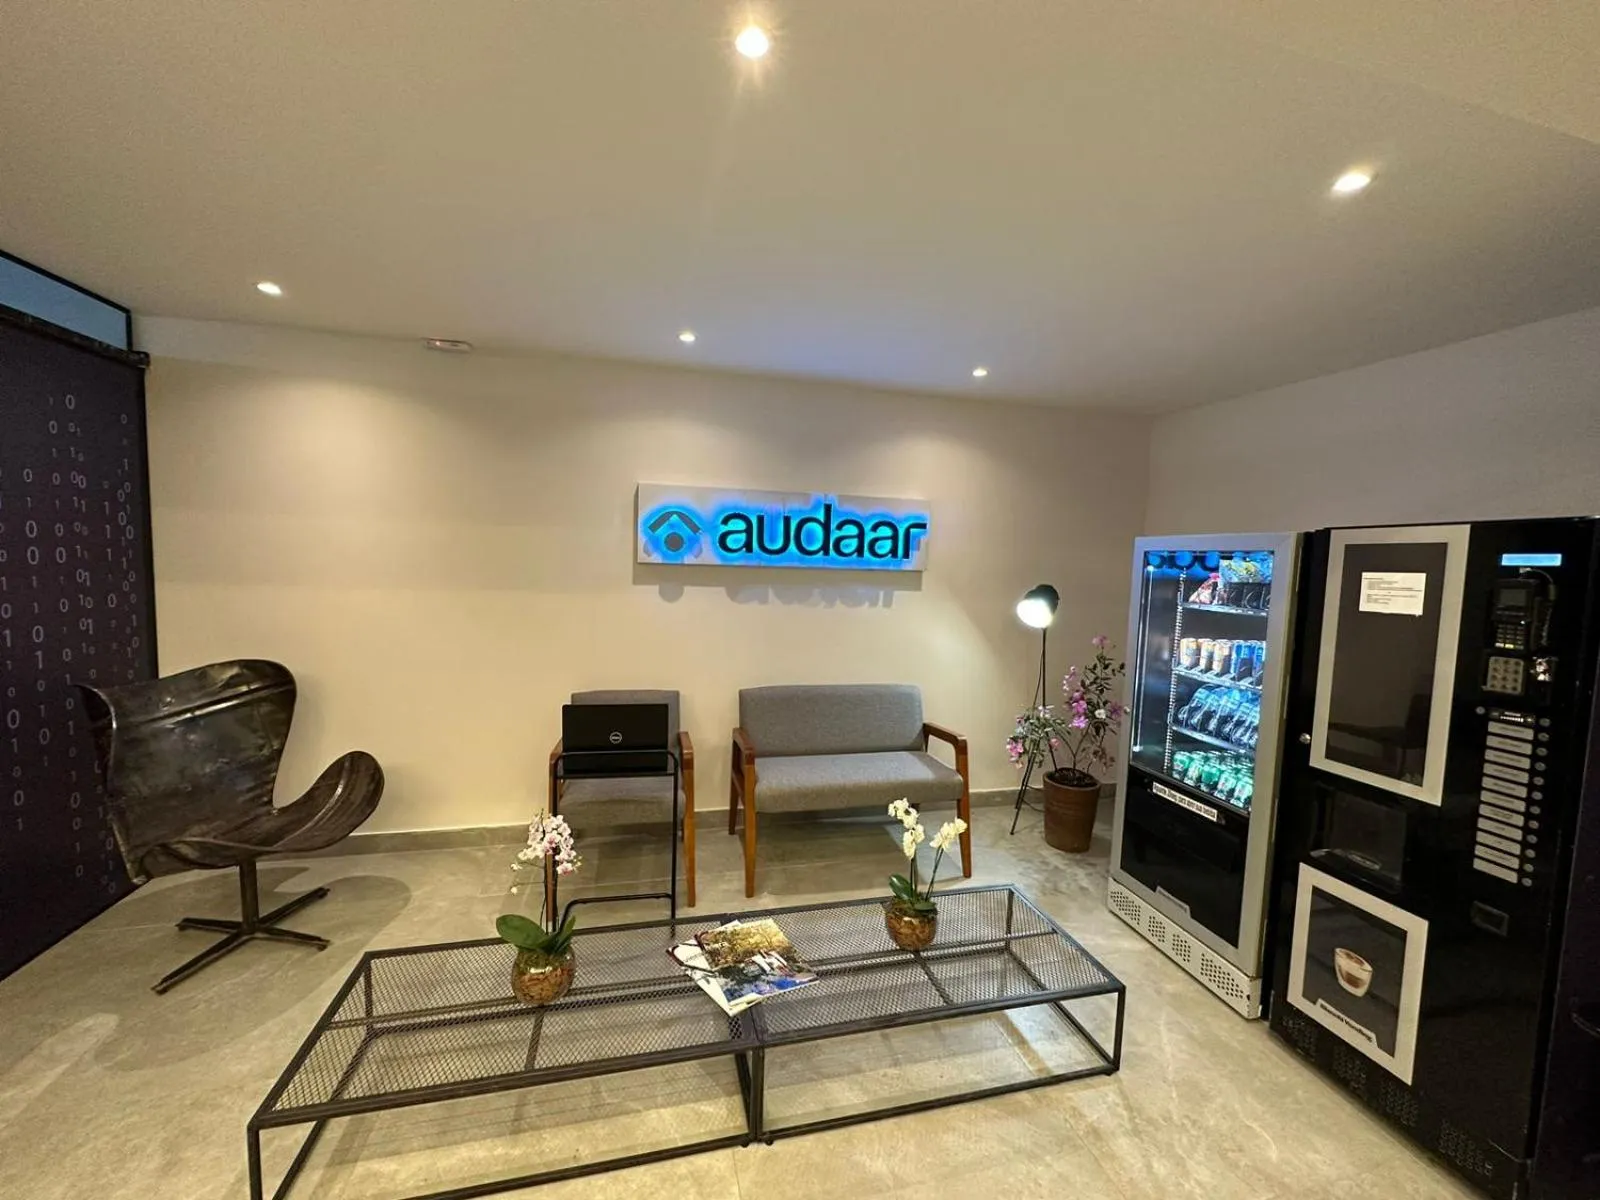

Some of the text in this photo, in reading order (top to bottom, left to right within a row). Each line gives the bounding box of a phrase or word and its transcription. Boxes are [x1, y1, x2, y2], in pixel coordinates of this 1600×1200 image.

[65, 394, 75, 410] 0
[121, 414, 128, 424] 0
[48, 420, 58, 434] 0
[23, 468, 33, 482] 0
[52, 472, 61, 485] 0
[124, 482, 131, 493] 0
[117, 489, 125, 502] 0
[118, 511, 127, 526] 0
[25, 520, 38, 538] 0
[54, 523, 64, 537] 0
[126, 525, 134, 539] 0
[718, 503, 927, 559] audaar
[27, 546, 39, 565] 0
[55, 547, 67, 563] 0
[128, 571, 136, 582] 0
[123, 580, 130, 592] 0
[59, 598, 69, 612] 0
[107, 593, 117, 608] 0
[1, 603, 12, 619] 0
[32, 626, 44, 643] 0
[132, 637, 140, 648] 0
[62, 648, 72, 661] 0
[7, 687, 17, 698] 0
[37, 680, 45, 692] 0
[66, 698, 74, 710] 0
[7, 709, 20, 729] 0
[39, 728, 50, 745] 0
[14, 790, 24, 806] 0
[70, 792, 81, 808] 0
[72, 817, 81, 830] 0
[106, 837, 114, 850] 0
[75, 865, 83, 877] 0
